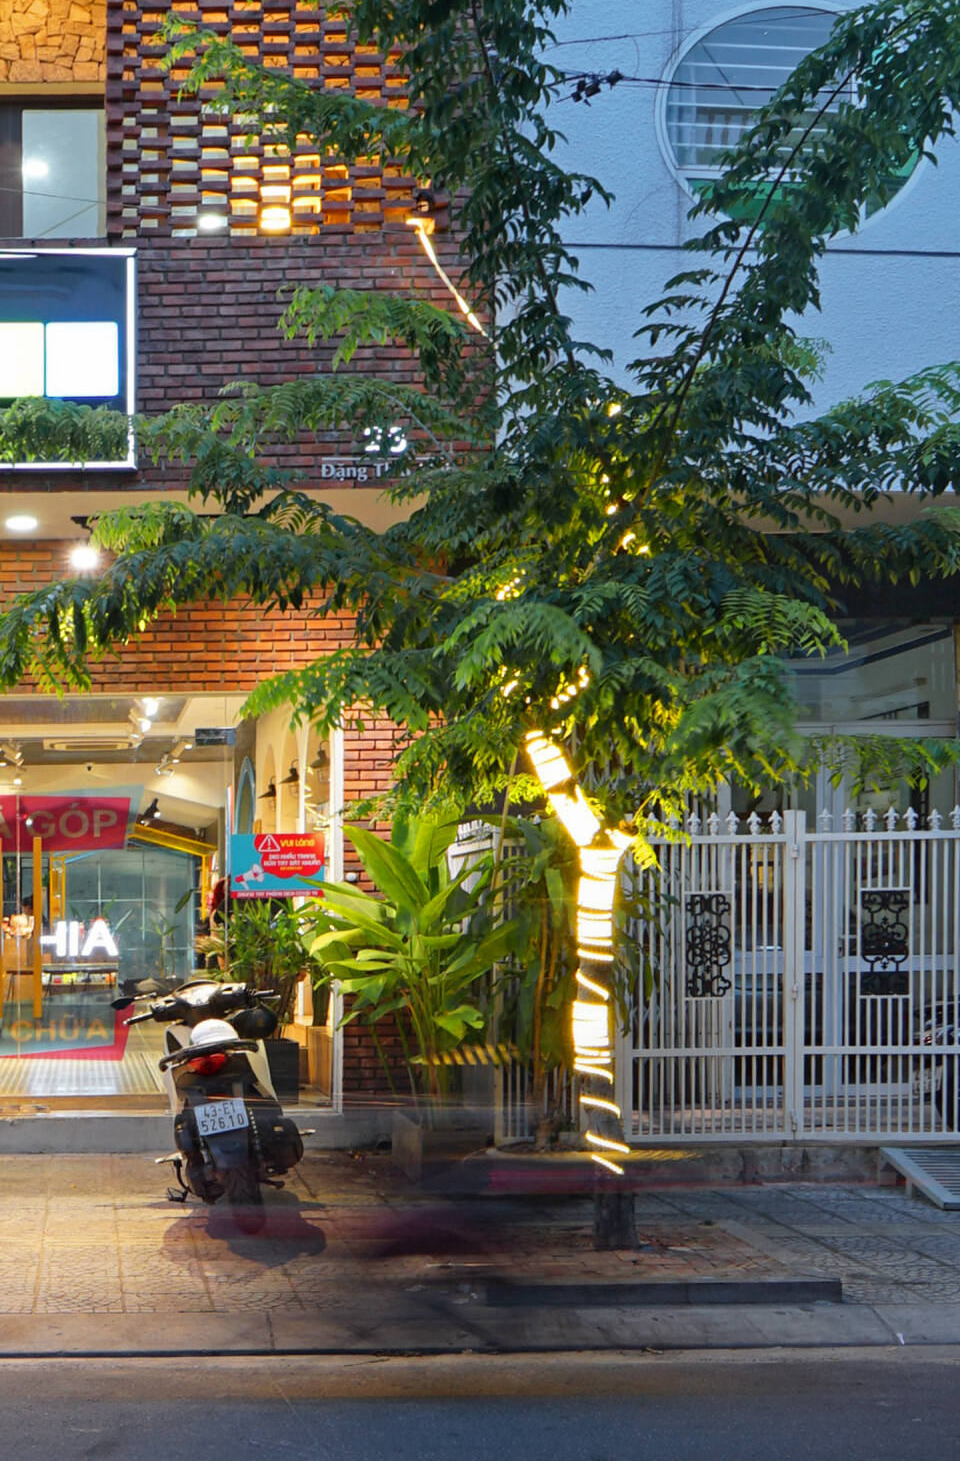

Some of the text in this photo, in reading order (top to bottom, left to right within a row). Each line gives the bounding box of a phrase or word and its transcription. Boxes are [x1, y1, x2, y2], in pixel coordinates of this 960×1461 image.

[320, 463, 369, 483] Đặng
[25, 802, 118, 839] GÓP
[280, 839, 294, 847] VUI
[203, 1101, 236, 1118] 43-E1
[200, 1113, 245, 1133] 526.10
